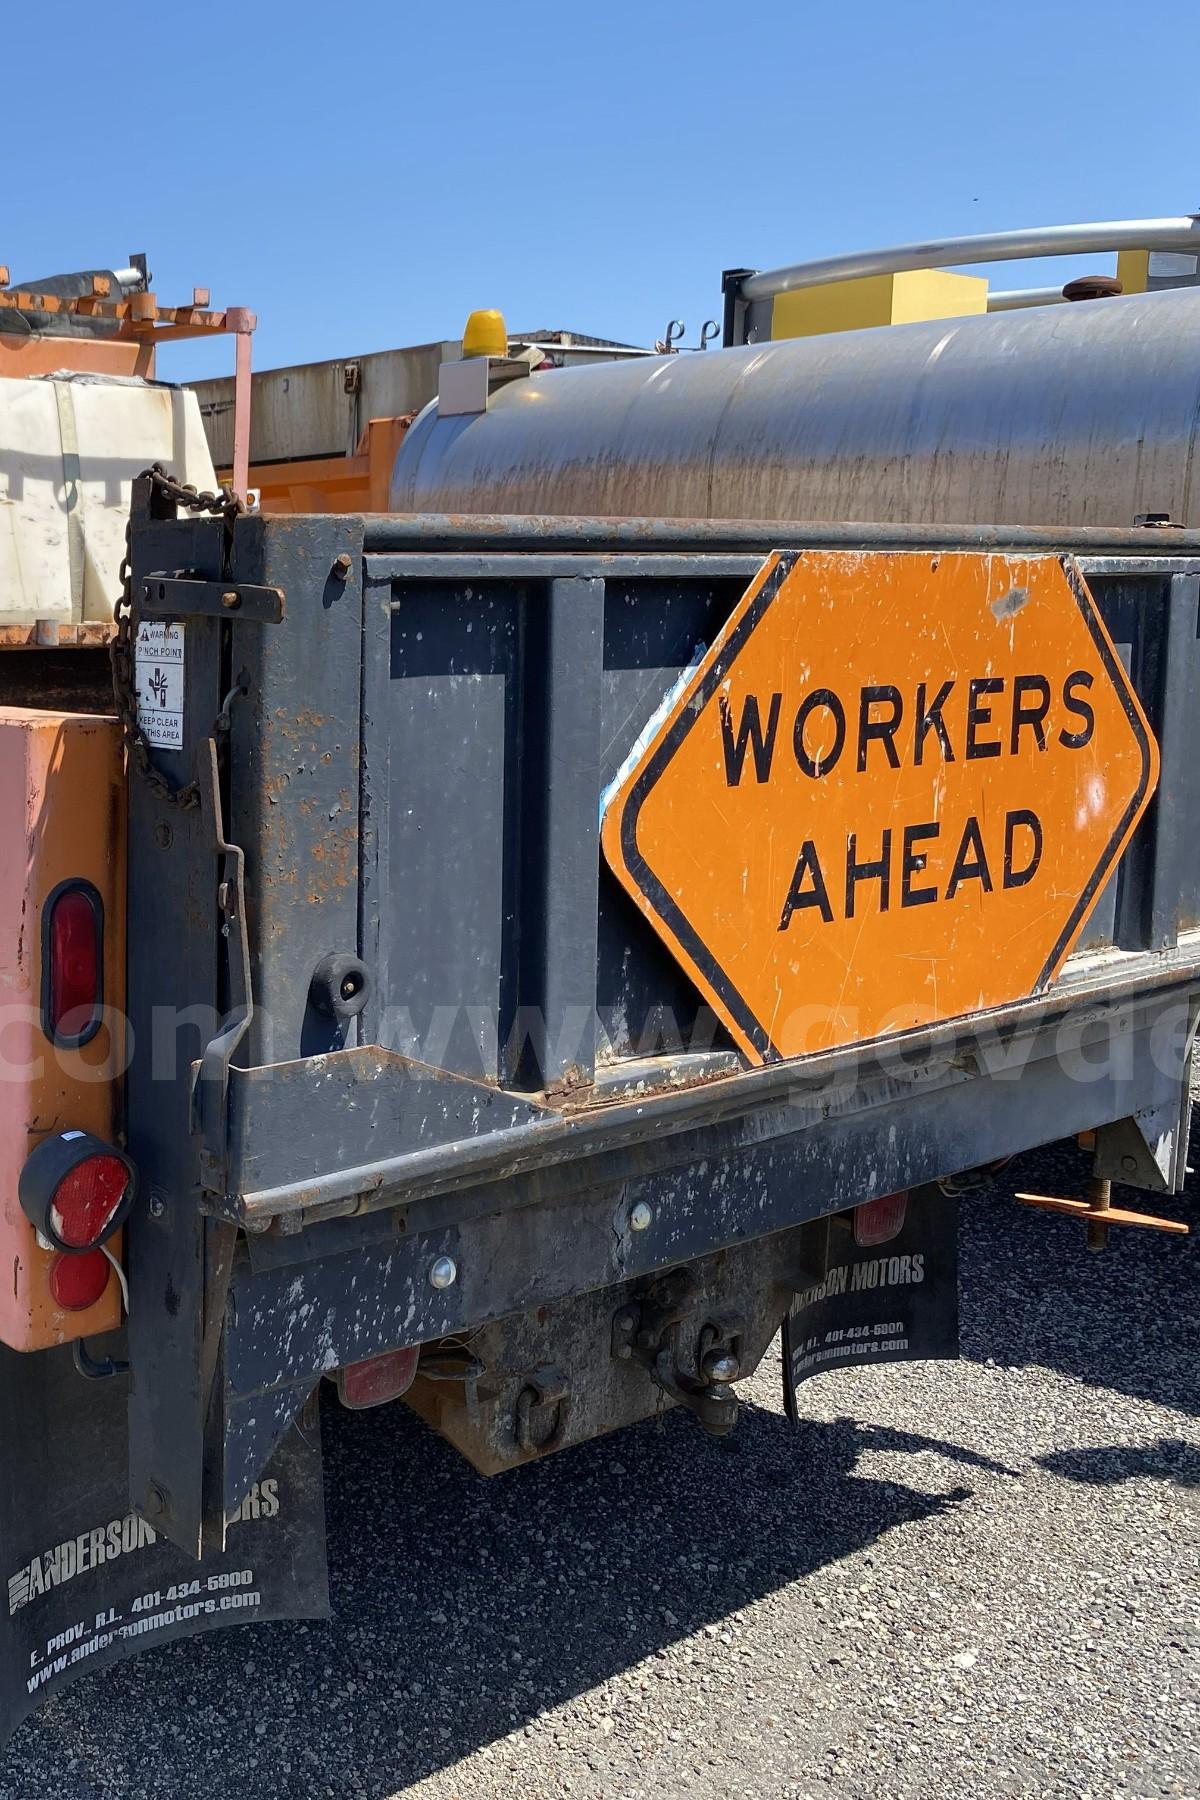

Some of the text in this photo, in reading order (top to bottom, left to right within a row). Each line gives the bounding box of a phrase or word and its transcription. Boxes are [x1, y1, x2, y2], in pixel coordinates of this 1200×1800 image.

[150, 630, 179, 640] WARNING
[138, 646, 182, 657] PINCH POINT
[147, 729, 160, 737] THIS
[162, 730, 179, 740] AREA
[157, 718, 178, 727] CLEAR
[718, 670, 1095, 787] WORKERS
[777, 809, 1043, 932] AHEAD
[851, 1254, 924, 1292] MOTORS
[29, 1512, 156, 1600] ANDERSON
